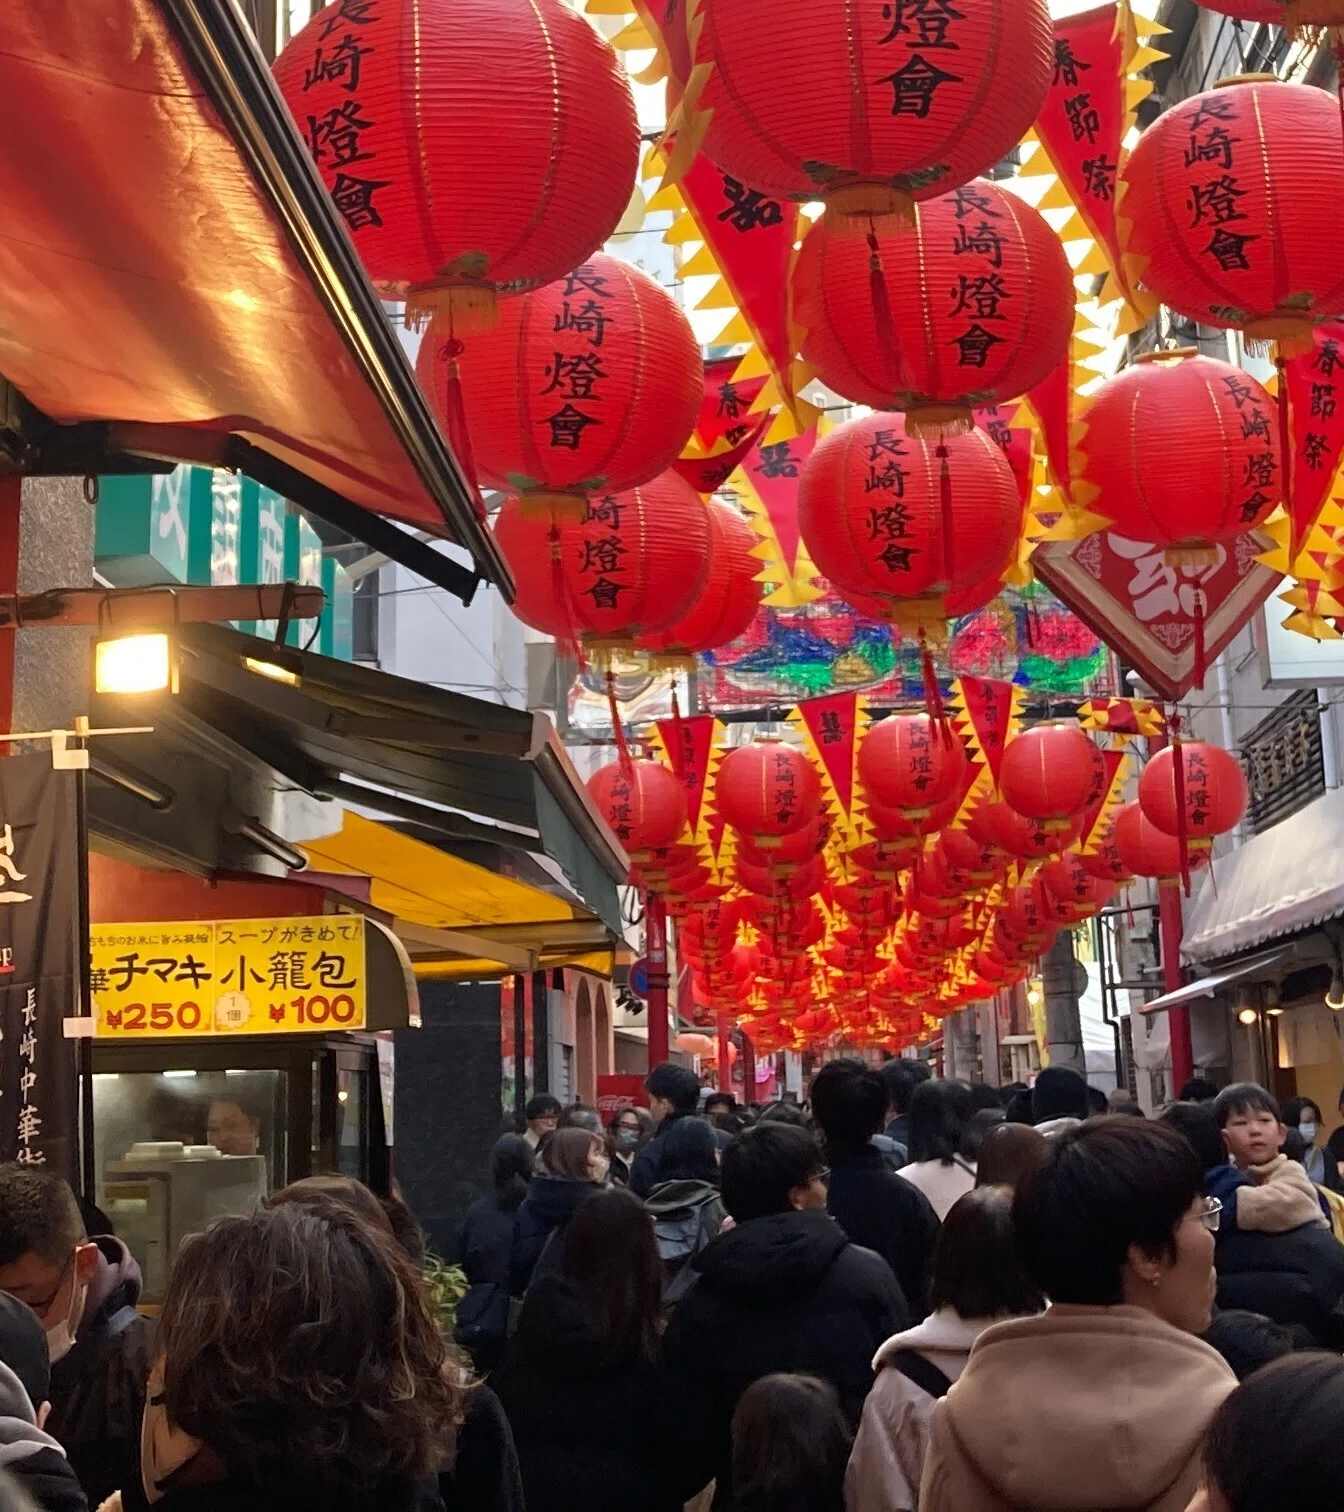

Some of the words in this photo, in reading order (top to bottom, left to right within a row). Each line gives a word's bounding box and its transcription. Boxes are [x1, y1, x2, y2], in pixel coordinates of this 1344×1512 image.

[1052, 37, 1116, 202] 春節祭
[1183, 92, 1257, 272] 長崎燈會
[946, 186, 1013, 369] 長崎燈會
[539, 258, 616, 452] 長崎燈會
[863, 429, 923, 573] 長崎燈會
[1219, 373, 1280, 524] 長崎燈會
[773, 752, 800, 824] 長崎燈會
[87, 952, 212, 995] 華チマキ
[106, 1000, 202, 1031] ¥250
[219, 949, 357, 992] 小籠包
[269, 993, 356, 1025] ¥100
